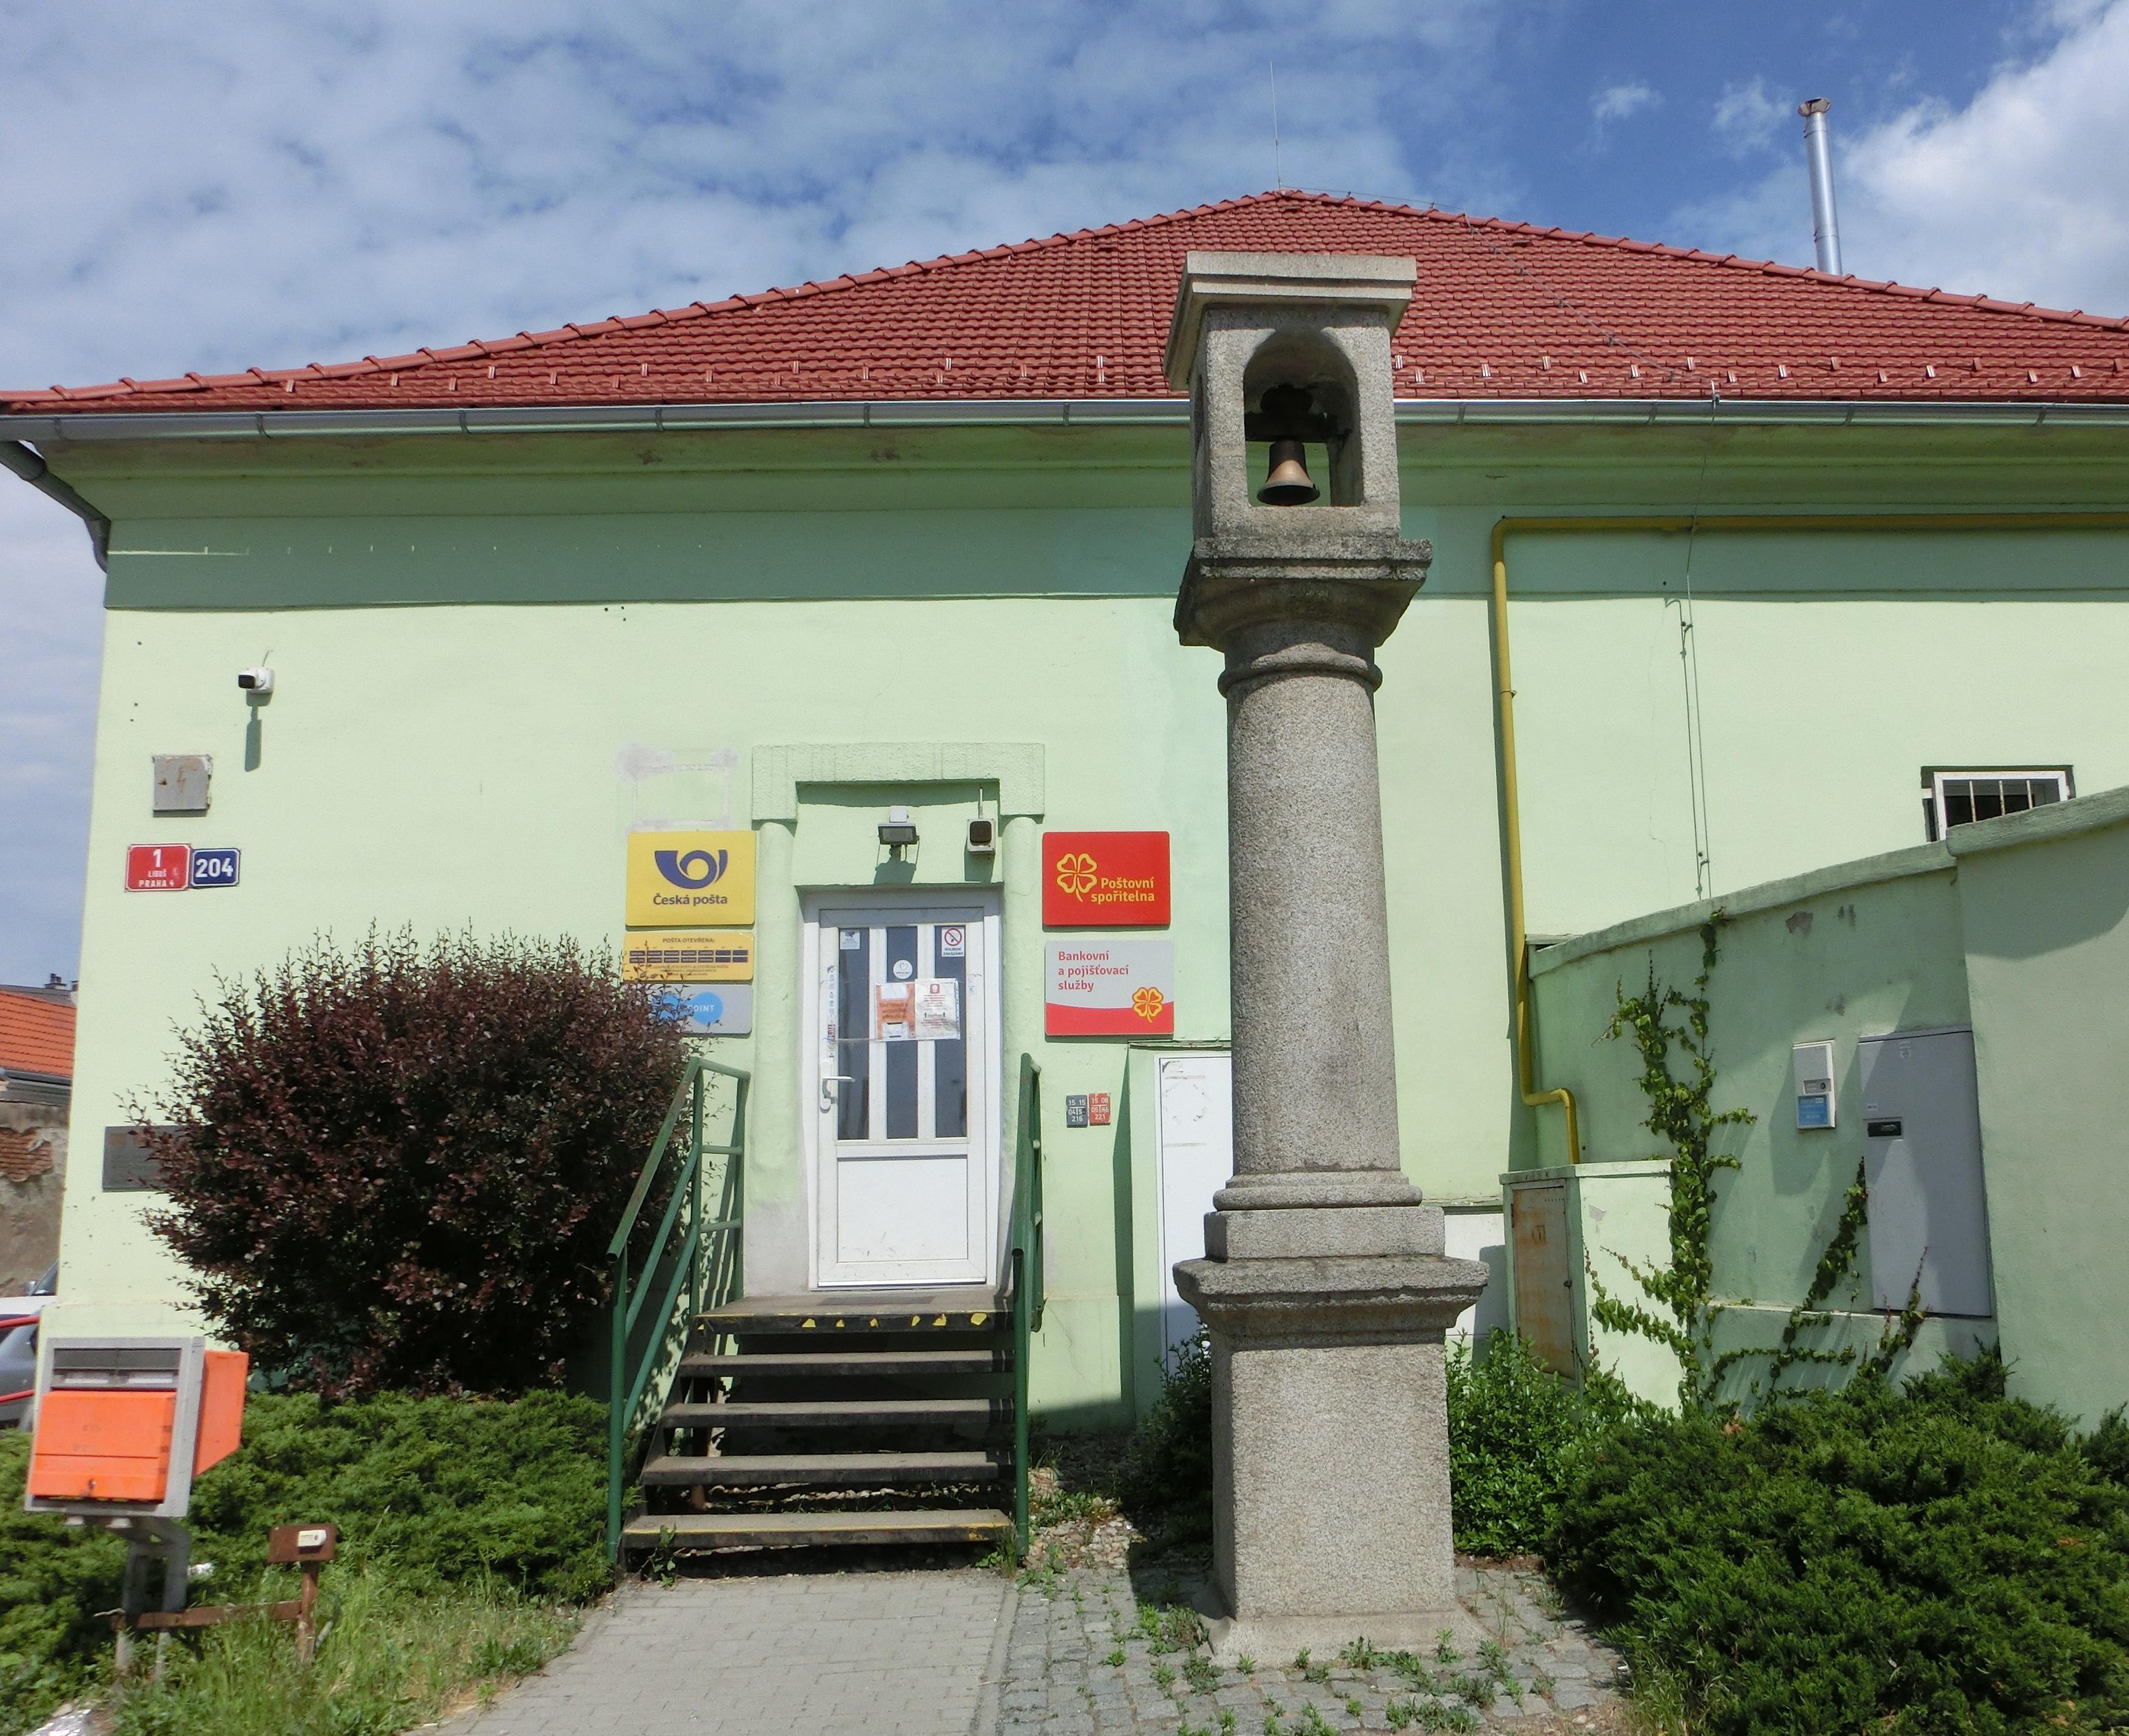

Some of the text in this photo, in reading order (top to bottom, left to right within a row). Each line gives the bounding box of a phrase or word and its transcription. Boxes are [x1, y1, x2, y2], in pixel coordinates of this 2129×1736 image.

[153, 849, 161, 867] 1
[196, 858, 234, 878] 204
[138, 879, 174, 888] PRAHA 4
[1101, 877, 1154, 889] Poštovní
[653, 892, 728, 907] Česká pošta
[1091, 890, 1155, 904] spořitelna
[1058, 950, 1109, 961] Bankovní
[1058, 964, 1129, 979] a pojišťovací
[1058, 980, 1094, 992] služby
